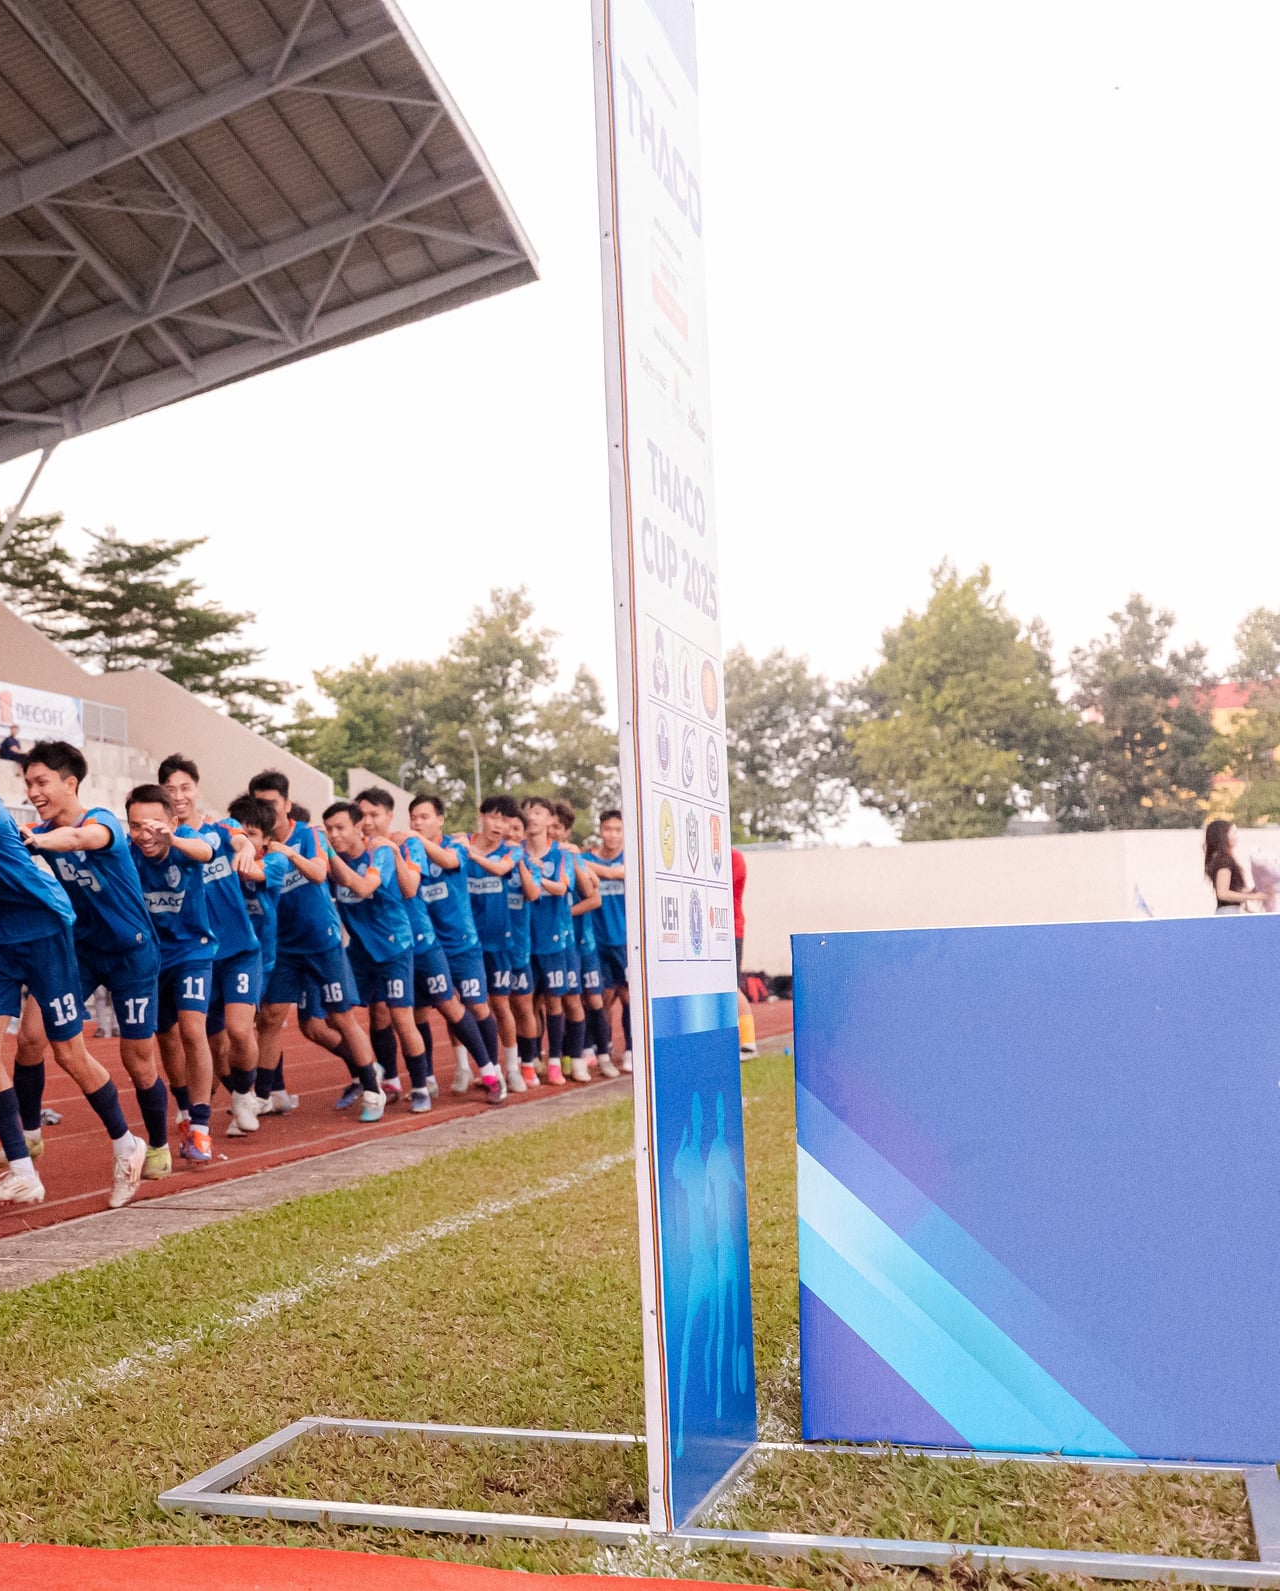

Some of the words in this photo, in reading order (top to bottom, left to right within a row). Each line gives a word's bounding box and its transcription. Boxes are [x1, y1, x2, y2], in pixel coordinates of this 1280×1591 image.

[620, 58, 702, 239] THACO
[646, 437, 706, 538] THACO
[641, 516, 678, 589] CUP
[682, 548, 718, 622] 2025
[203, 863, 225, 878] ACO
[660, 896, 680, 931] UEH
[182, 976, 206, 1001] 11
[236, 973, 250, 995] 3
[387, 978, 404, 999] 19
[427, 973, 448, 995] 23
[461, 978, 481, 997] 22
[493, 970, 511, 988] 14
[322, 982, 344, 1003] 16
[49, 992, 79, 1027] 13
[124, 996, 150, 1025] 17
